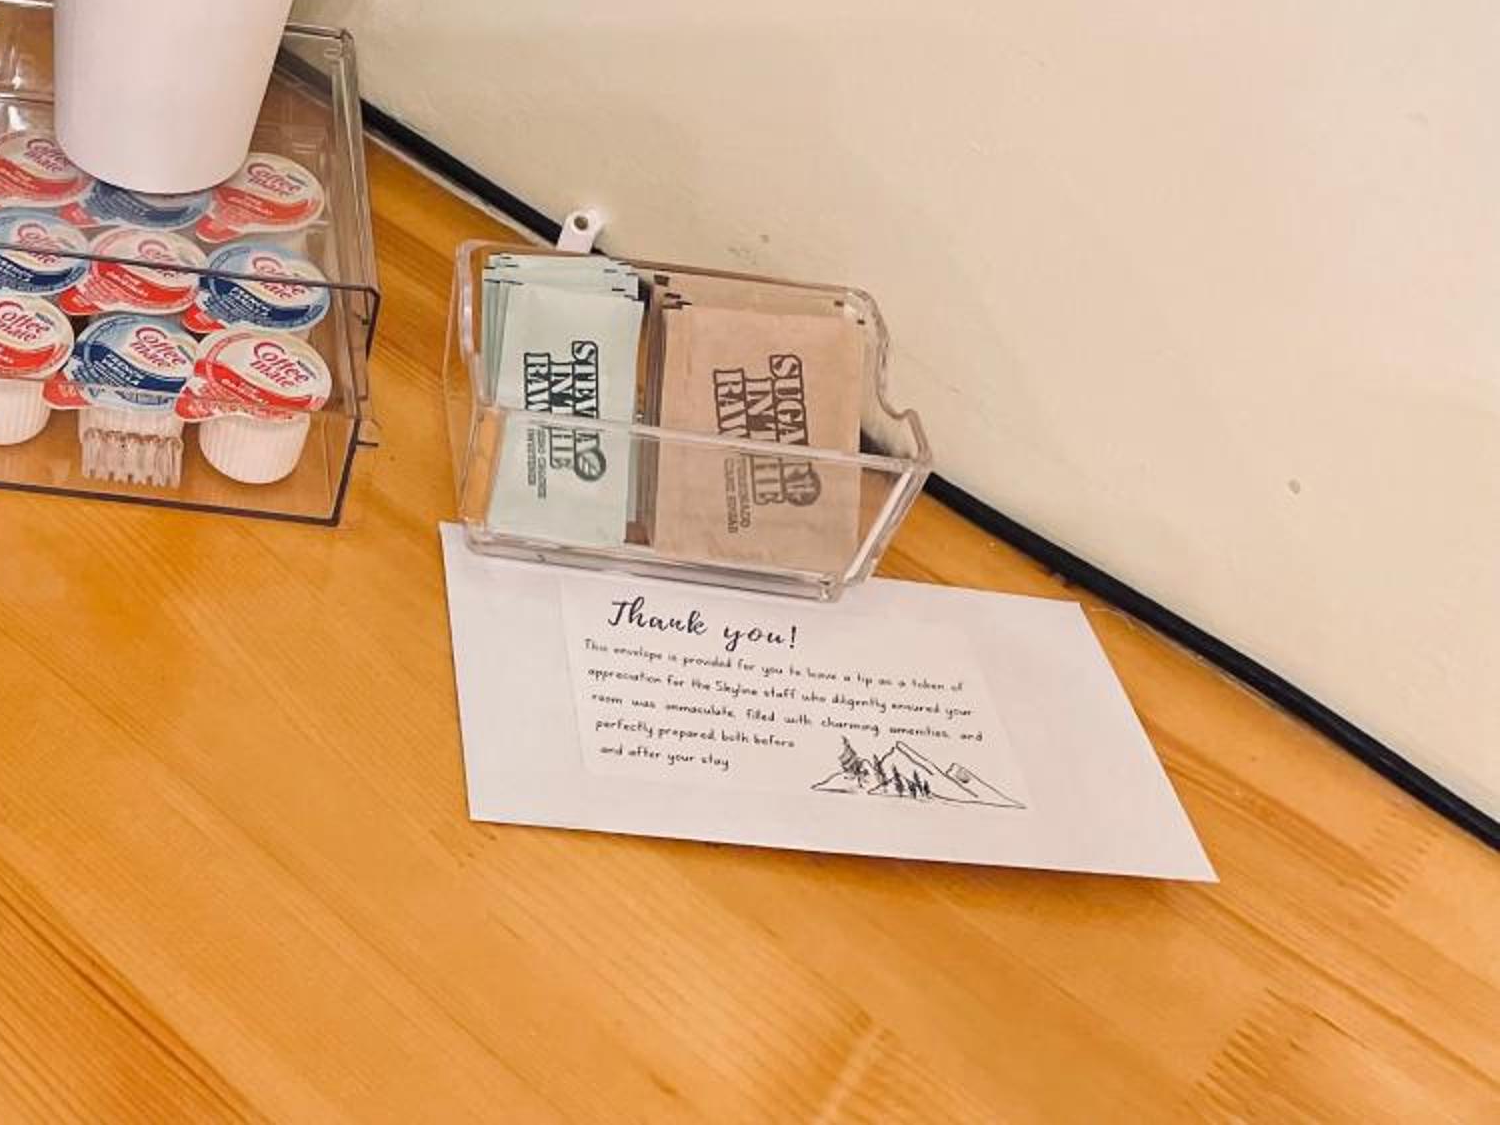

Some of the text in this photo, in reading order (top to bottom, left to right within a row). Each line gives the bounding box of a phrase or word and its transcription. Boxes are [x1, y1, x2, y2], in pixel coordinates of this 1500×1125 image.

[130, 341, 172, 367] mate
[135, 326, 187, 365] Coffee
[253, 341, 309, 384] Coffee
[250, 359, 296, 388] mate
[608, 596, 798, 652] Thank you!
[585, 638, 609, 652] This
[613, 646, 663, 662] envelope
[667, 651, 677, 662] is
[683, 654, 732, 668] provided
[737, 658, 755, 671] for
[761, 666, 784, 678] you
[790, 666, 801, 677] to
[807, 666, 837, 681] leave
[857, 672, 873, 688] tip
[878, 678, 892, 686] as
[912, 678, 945, 691] token
[950, 682, 963, 692] of
[588, 667, 662, 685] appreciation
[667, 674, 685, 687] for
[691, 677, 711, 691] the
[715, 680, 758, 698] Skyline
[763, 686, 797, 700] staff
[801, 692, 827, 703] who
[891, 702, 940, 714] ensured
[945, 708, 972, 720] your
[591, 693, 623, 705] room
[631, 700, 656, 709] was
[746, 708, 776, 722] filled
[784, 714, 812, 725] with
[821, 717, 879, 737] charming
[960, 731, 983, 742] and
[595, 719, 653, 738] perfectly
[721, 730, 749, 744] both
[753, 734, 796, 748] before
[600, 743, 623, 756] and
[628, 746, 661, 759] after
[667, 752, 695, 765] your
